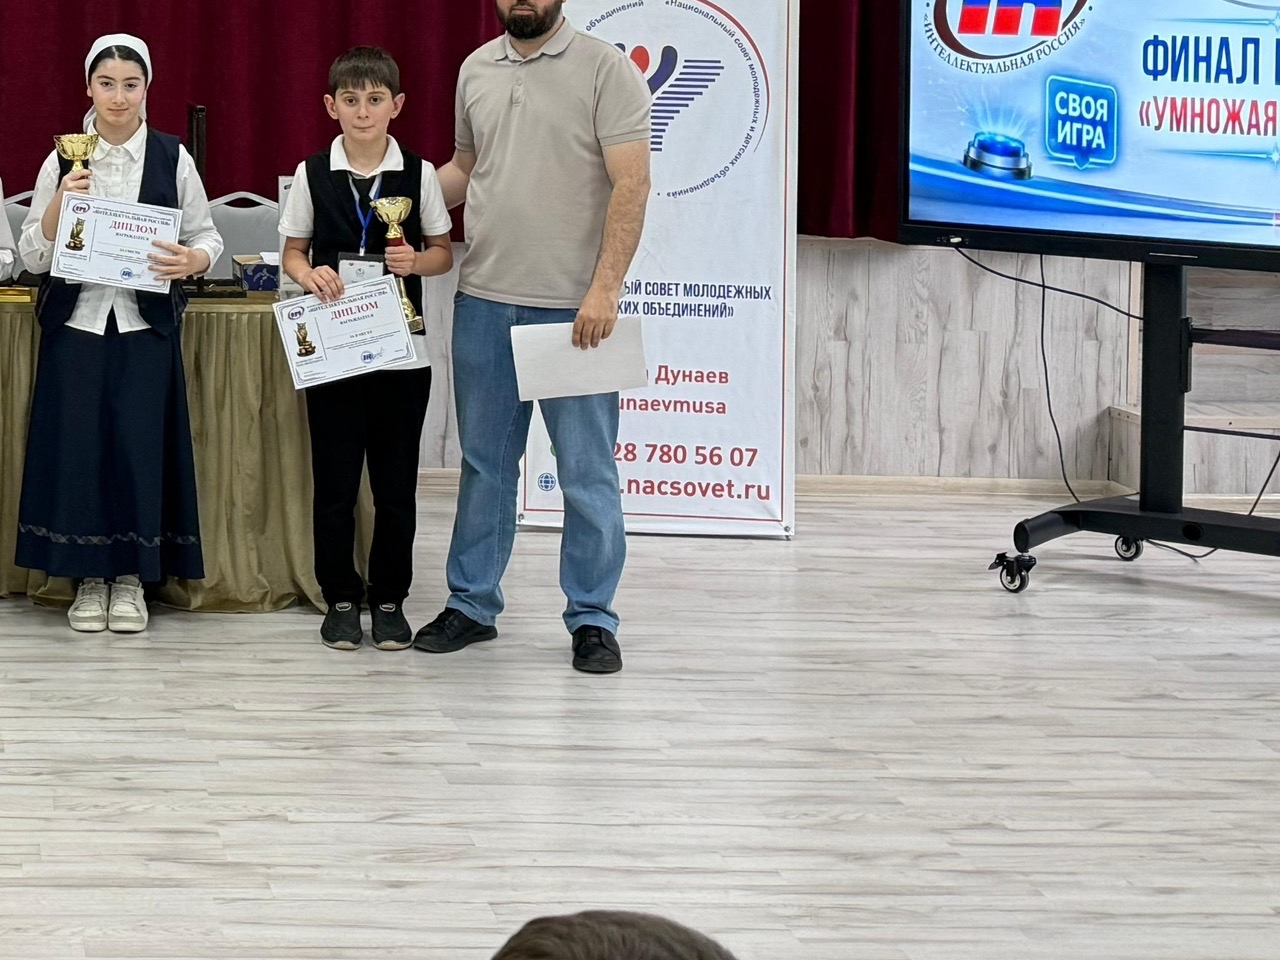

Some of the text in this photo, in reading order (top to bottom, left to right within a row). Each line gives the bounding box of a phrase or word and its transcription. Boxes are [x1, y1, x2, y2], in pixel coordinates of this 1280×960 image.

[585, 0, 644, 32] объединений
[733, 38, 752, 62] совет
[923, 13, 1086, 74] «ИНТЕЛЛЕКТУАЛЬНАЯ РОССИЯ»
[1142, 34, 1260, 85] ФИНАЛ
[748, 63, 761, 124] молодежных
[1055, 91, 1108, 122] СВОЯ
[1138, 95, 1277, 137] «УМНОЖАЯ
[1057, 119, 1106, 150] ИГРА
[729, 133, 753, 167] детских
[666, 166, 730, 199] объединений»
[109, 220, 157, 236] ДИПЛОМ
[644, 282, 680, 297] СОВЕТ
[683, 283, 772, 300] МОЛОДЕЖНЫХ
[330, 301, 379, 321] ДИПЛОМ
[642, 301, 734, 318] ОБЪЕДИНЕНИЙ»
[654, 364, 729, 386] Дунаев
[619, 397, 727, 415] naevmusa
[613, 442, 758, 467] 28 780 56 07
[620, 478, 770, 501] .nacsovet.ru
